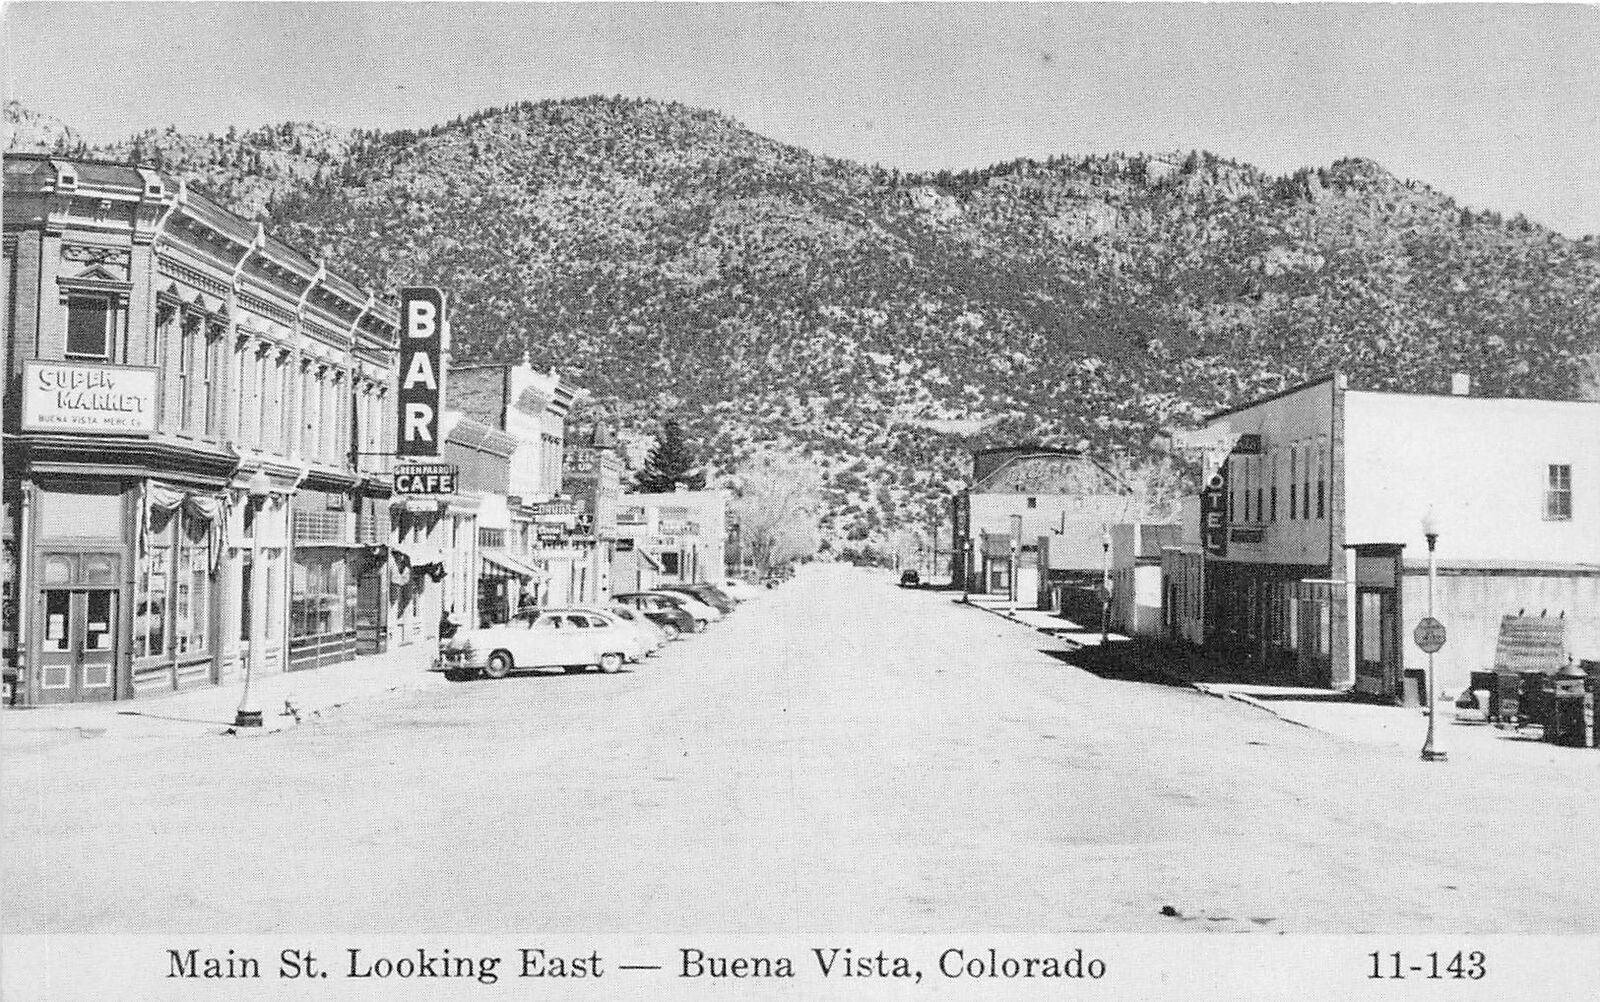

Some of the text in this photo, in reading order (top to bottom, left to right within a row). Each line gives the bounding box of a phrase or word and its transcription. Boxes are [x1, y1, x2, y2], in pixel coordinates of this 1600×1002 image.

[38, 368, 116, 392] SUPER
[403, 299, 437, 441] BAR
[57, 391, 148, 413] MARKET
[38, 414, 67, 423] BUENA
[71, 415, 98, 424] VISTA
[396, 475, 451, 492] CAFE
